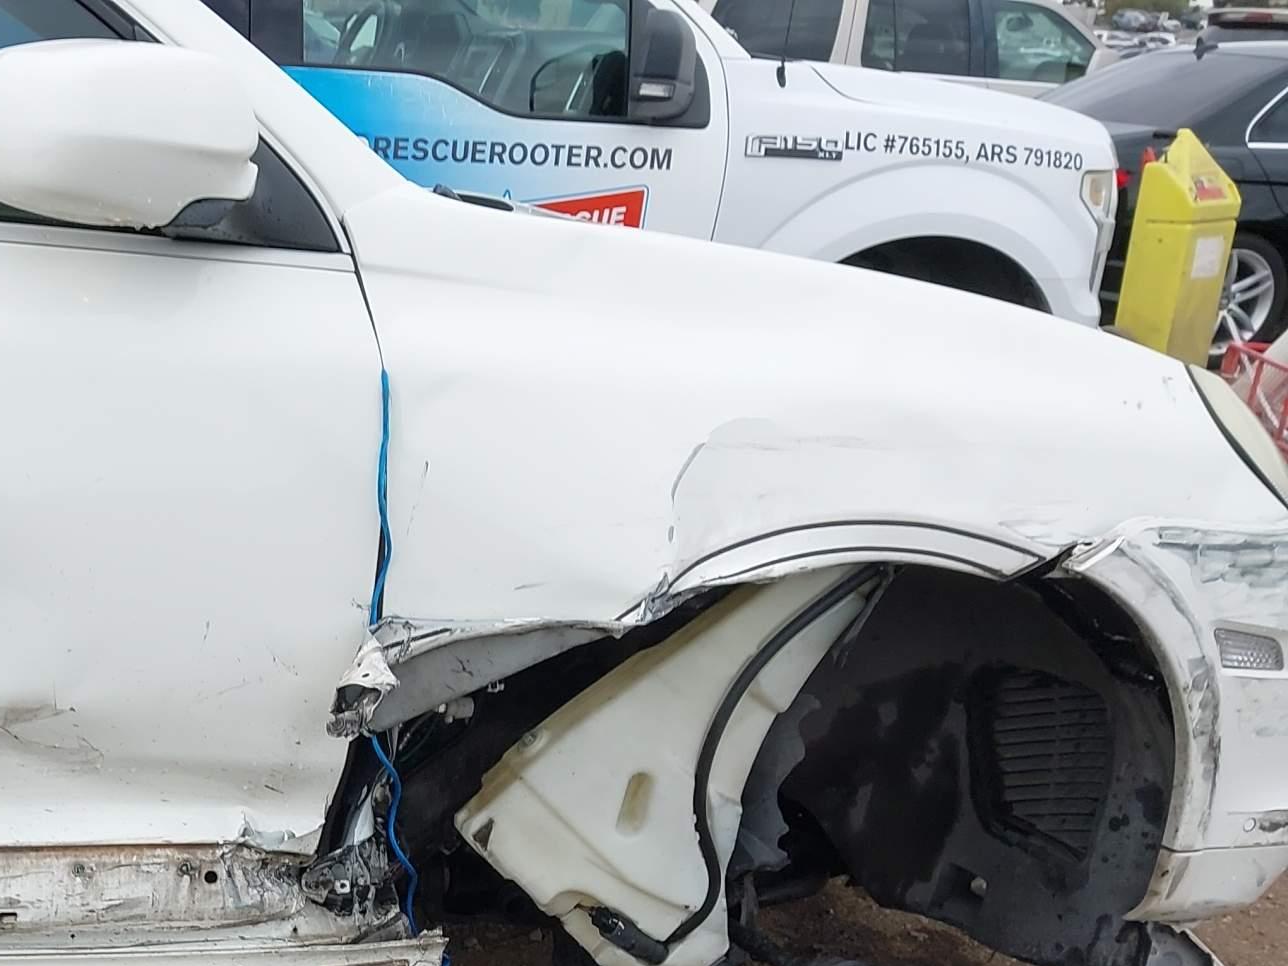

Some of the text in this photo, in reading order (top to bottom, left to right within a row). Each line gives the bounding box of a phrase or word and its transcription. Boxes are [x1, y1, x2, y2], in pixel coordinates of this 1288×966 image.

[357, 134, 673, 170] RESCUEROOTER.COM
[844, 130, 1084, 172] LIC #765155, ARS 791820
